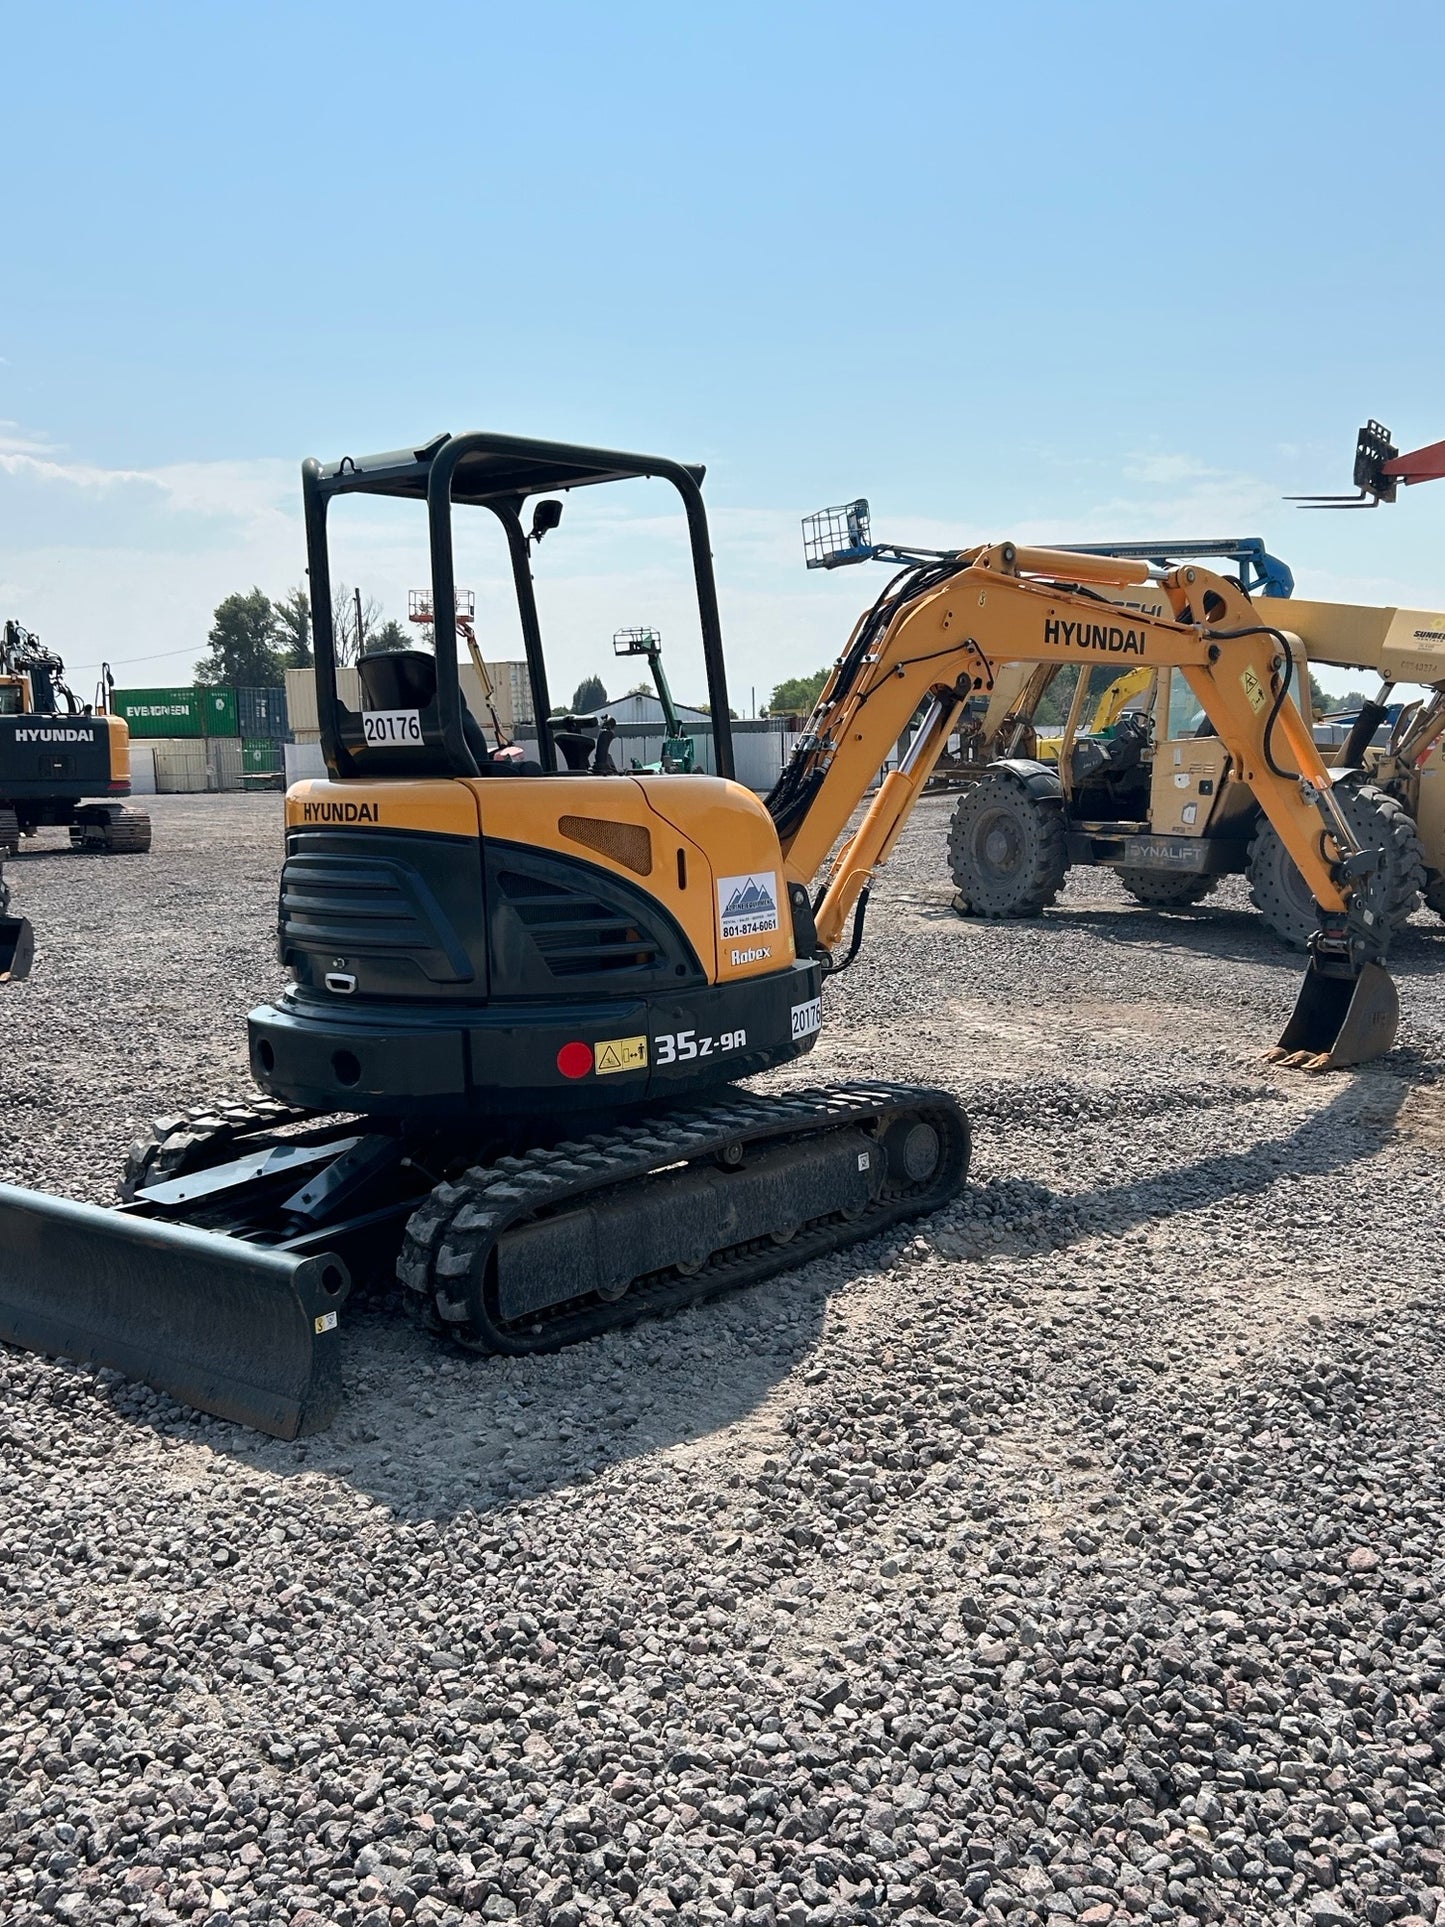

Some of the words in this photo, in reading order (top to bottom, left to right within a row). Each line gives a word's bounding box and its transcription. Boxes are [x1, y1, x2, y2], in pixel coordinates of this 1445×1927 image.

[1044, 619, 1145, 655] HYUNDAI
[126, 704, 189, 717] EVERGREEN
[15, 729, 94, 741] HYUNDAI
[364, 716, 420, 740] 20176
[304, 803, 379, 822] HYUNDAI
[1129, 845, 1202, 860] DYNALIFT
[723, 919, 777, 937] 801-874-6061
[731, 946, 771, 966] Robex
[792, 1004, 821, 1034] 20176
